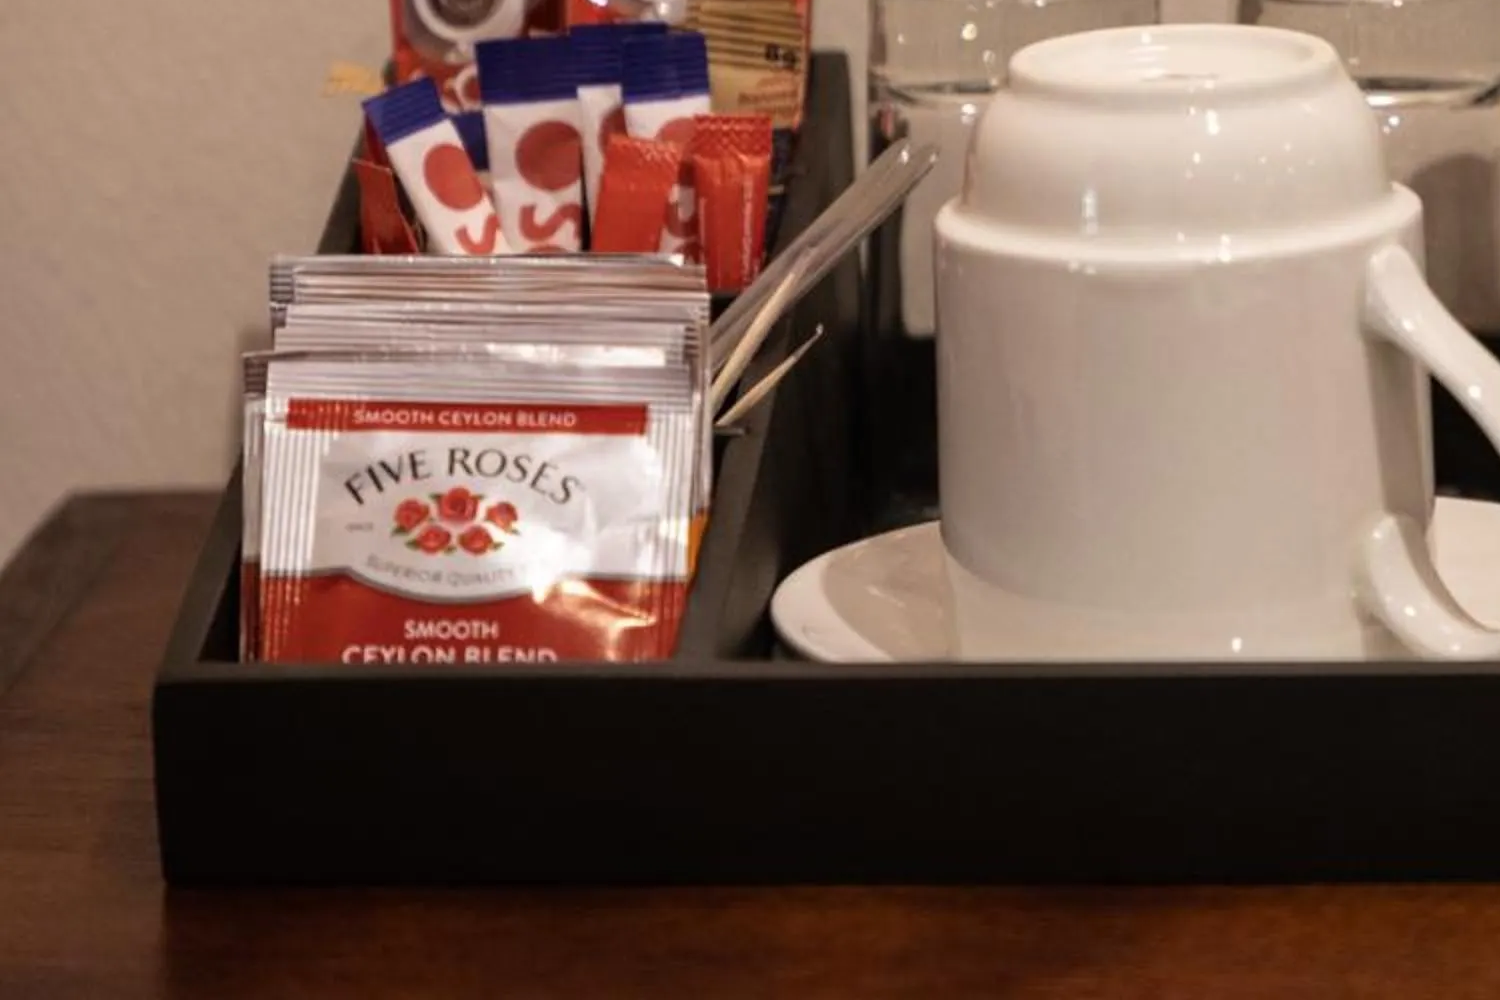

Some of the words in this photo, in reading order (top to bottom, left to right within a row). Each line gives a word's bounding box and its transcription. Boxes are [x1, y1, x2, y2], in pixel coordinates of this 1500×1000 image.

[353, 408, 435, 426] SMOOTH
[437, 410, 512, 427] CEYLON
[516, 411, 578, 428] BLEND
[343, 449, 433, 506] FIVE
[446, 447, 586, 506] ROSES
[403, 618, 500, 641] SMOOTH
[341, 644, 457, 665] CEYLON
[463, 645, 559, 665] BLEND
